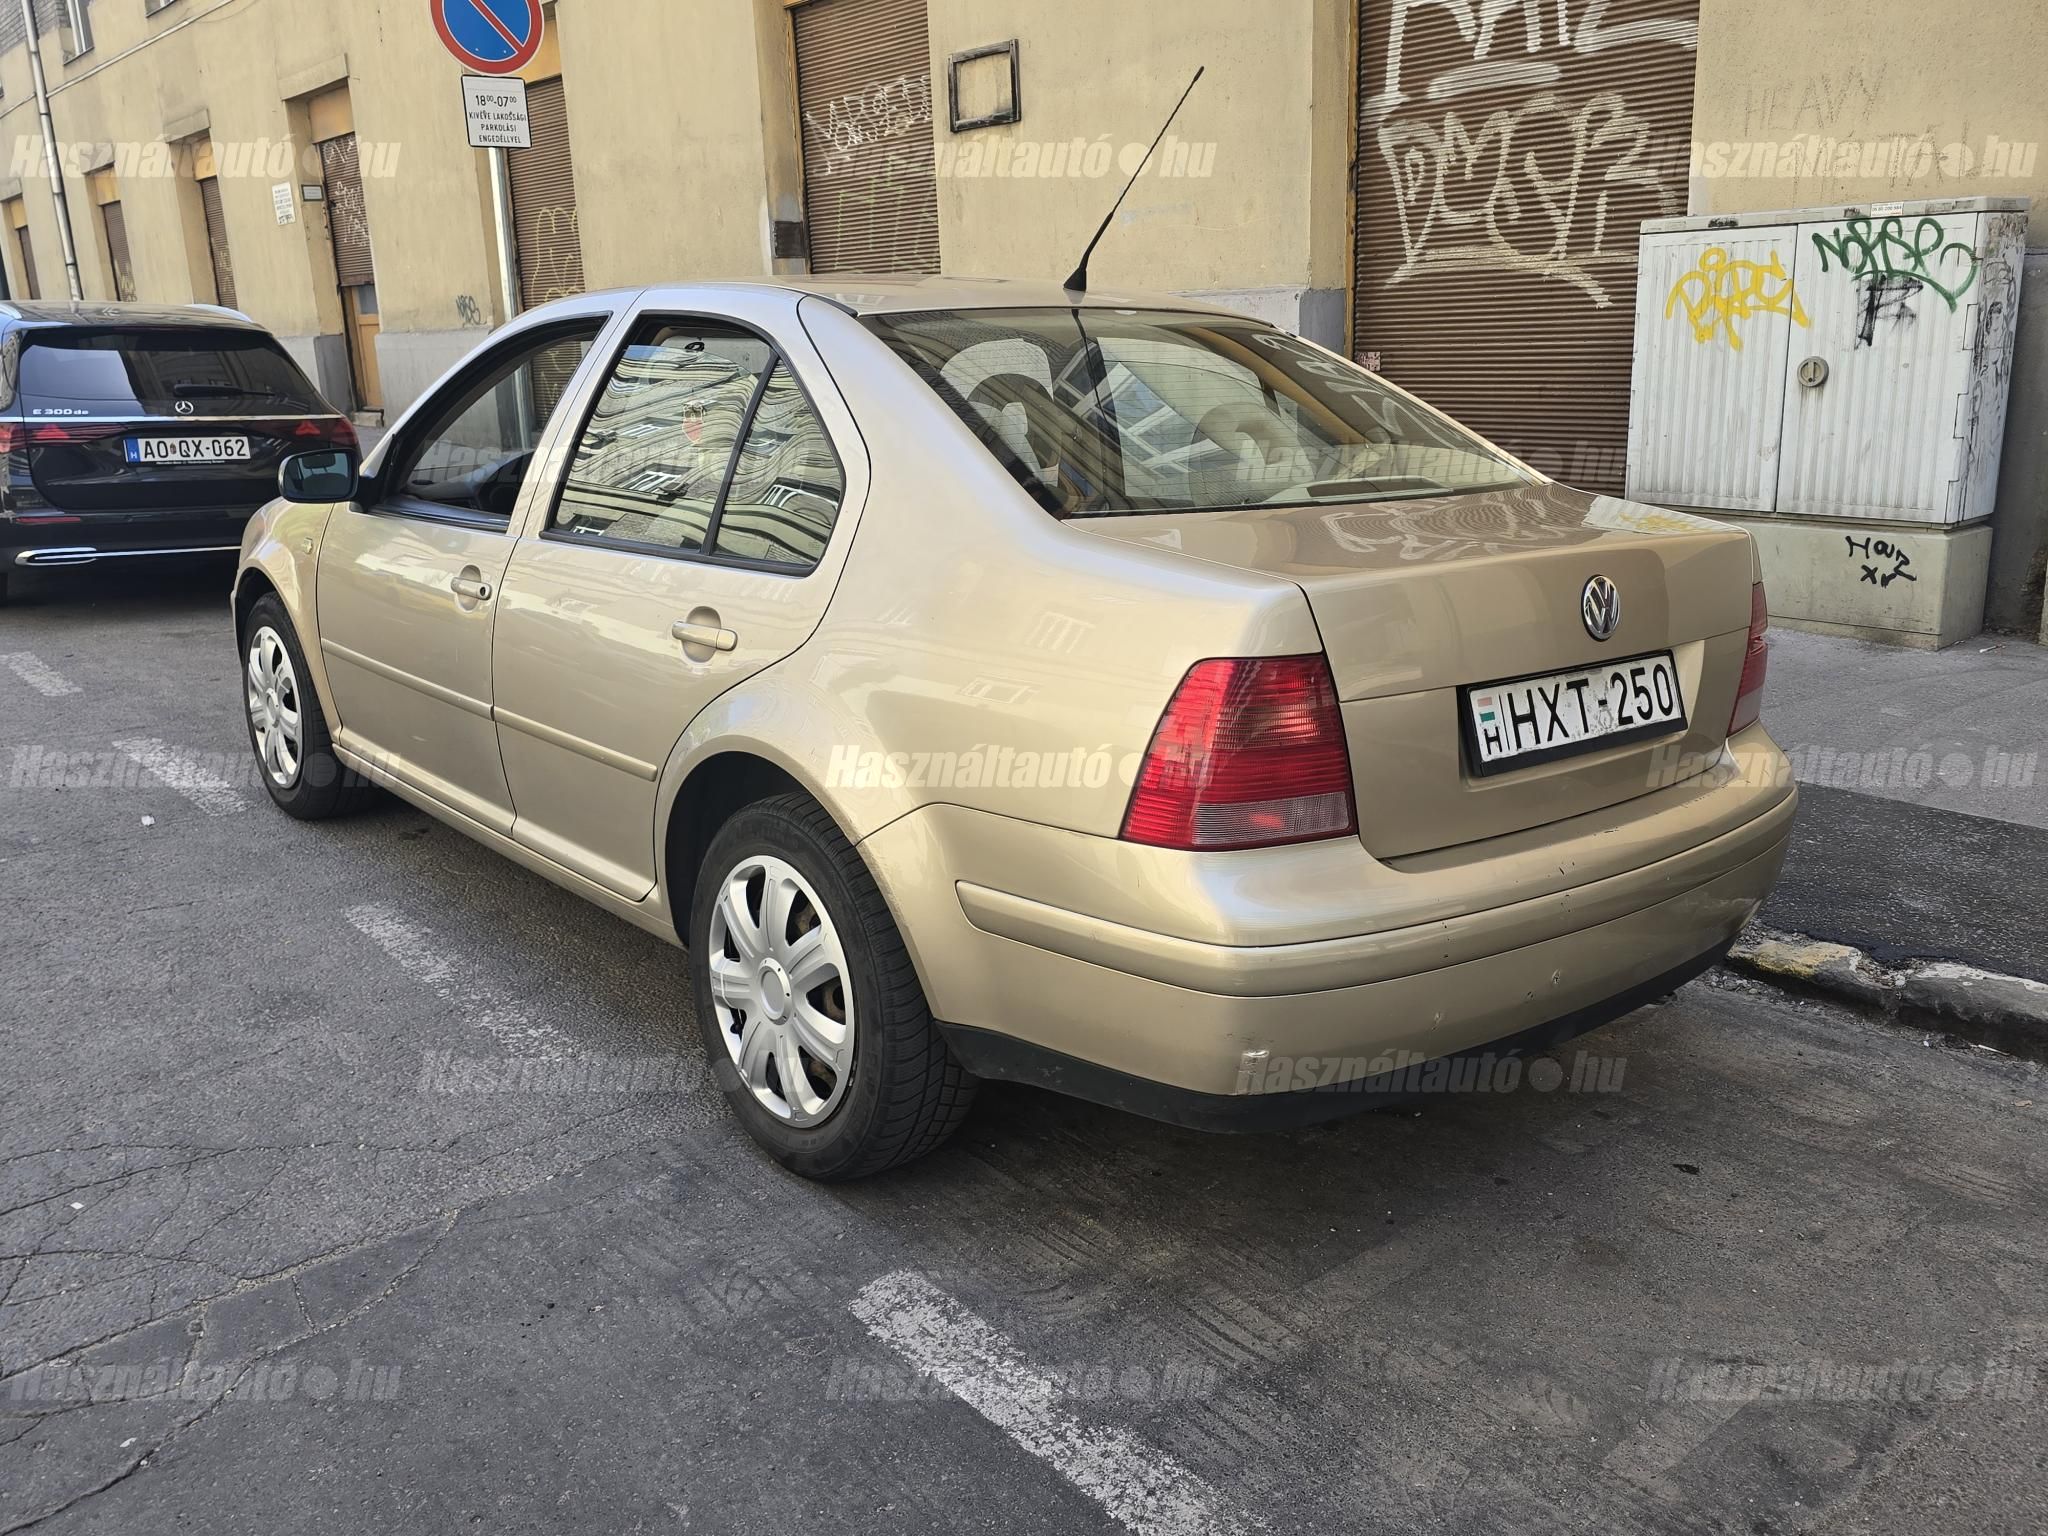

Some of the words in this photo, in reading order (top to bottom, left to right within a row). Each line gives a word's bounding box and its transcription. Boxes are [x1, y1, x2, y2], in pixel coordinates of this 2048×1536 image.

[480, 122, 517, 132] PARKOLÁSI
[178, 439, 247, 458] QX-062
[1507, 663, 1674, 750] HXT-250
